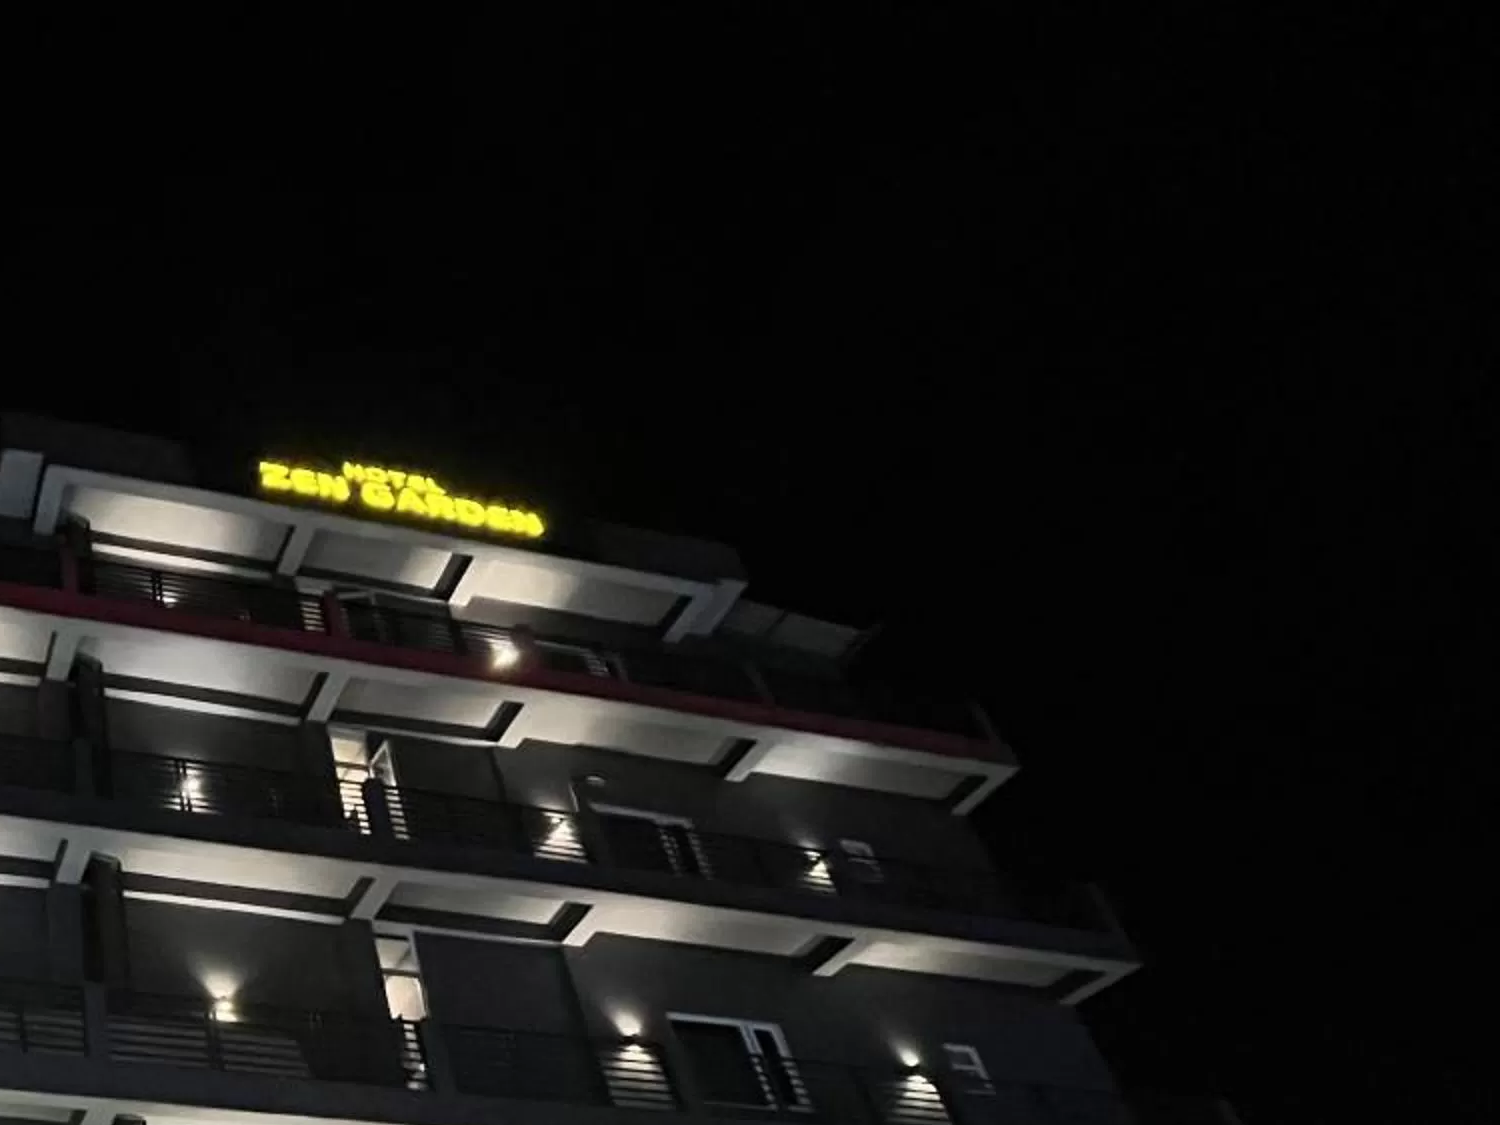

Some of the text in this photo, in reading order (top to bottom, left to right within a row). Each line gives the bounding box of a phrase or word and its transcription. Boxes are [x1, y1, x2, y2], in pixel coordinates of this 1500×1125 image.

[258, 461, 545, 538] ZEN GARDEN
[343, 461, 447, 495] HOTEL
